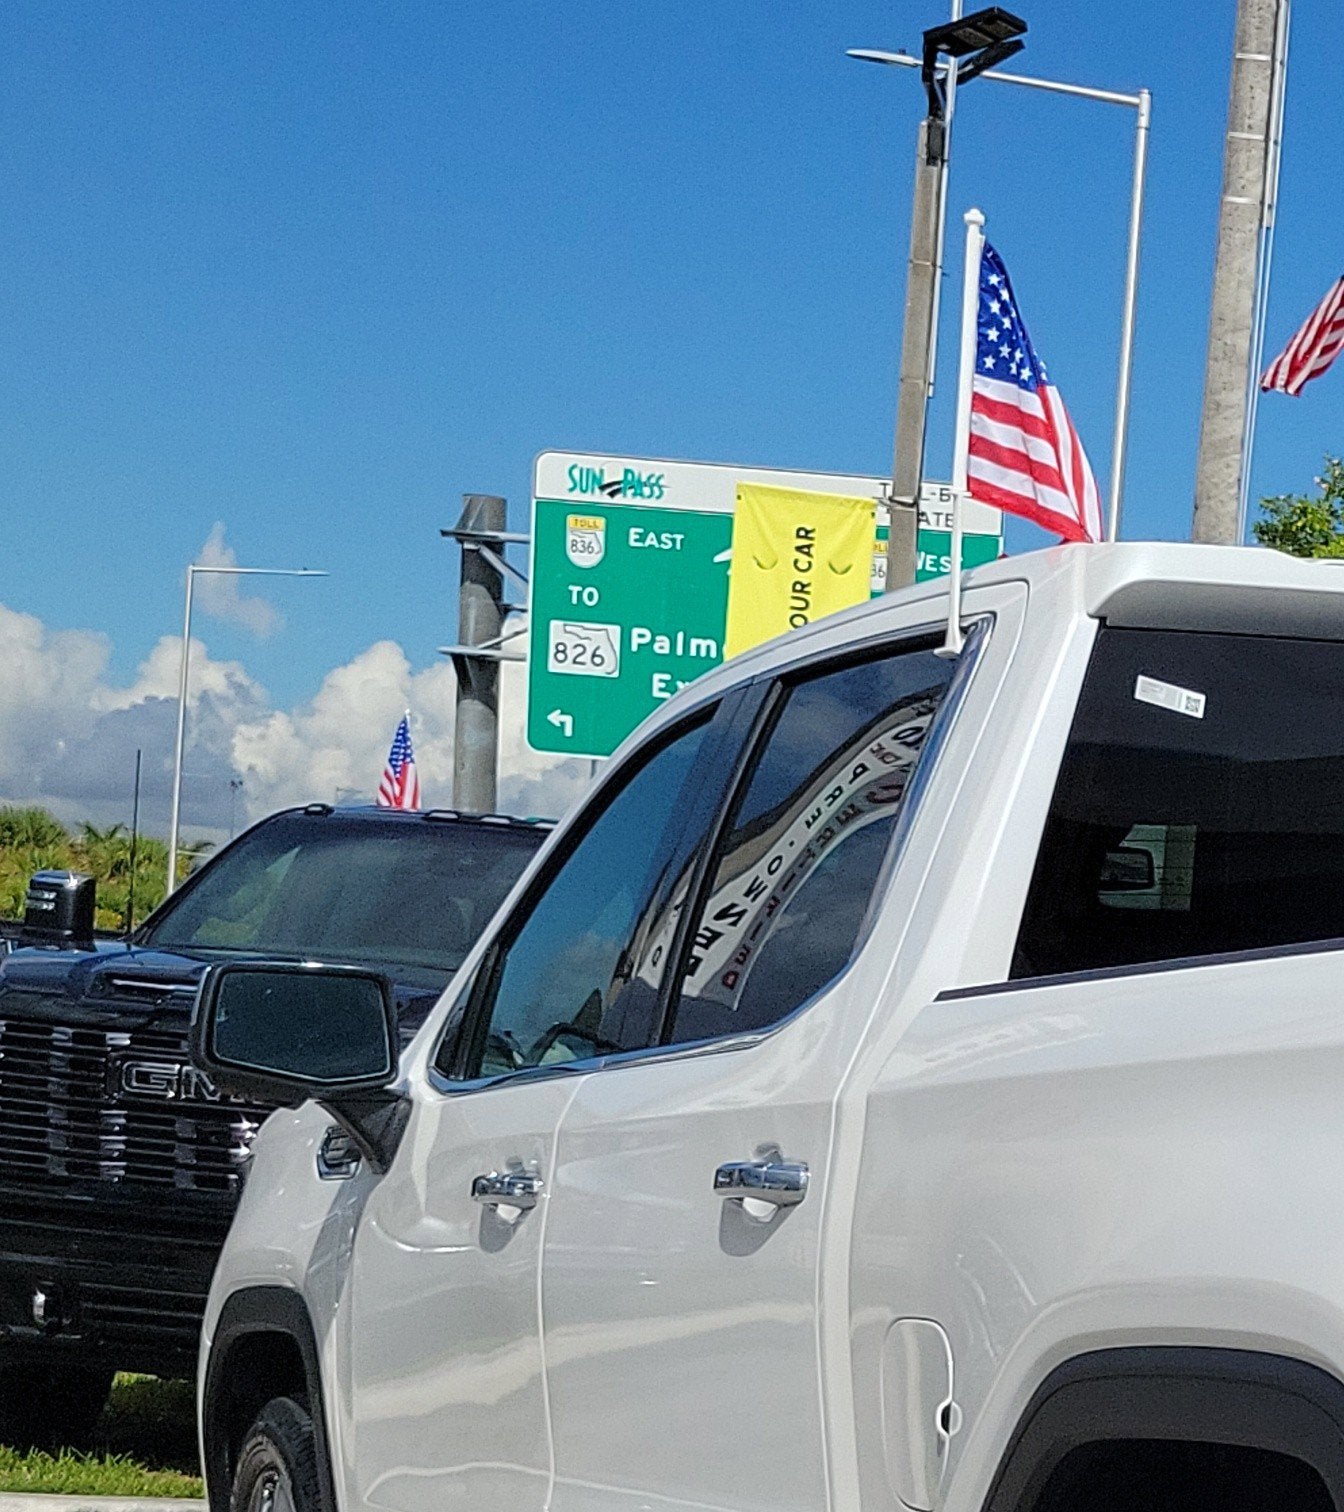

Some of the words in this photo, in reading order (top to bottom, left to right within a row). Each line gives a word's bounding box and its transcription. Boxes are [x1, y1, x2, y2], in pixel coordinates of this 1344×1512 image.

[567, 463, 604, 494] SUN
[622, 467, 664, 499] PASS
[573, 518, 599, 529] TOLL
[570, 538, 595, 555] 836
[628, 527, 684, 550] EAST
[793, 526, 816, 573] CAR
[568, 584, 599, 606] TO
[553, 641, 605, 667] 826
[631, 627, 718, 659] Palm
[121, 1058, 265, 1104] GM
